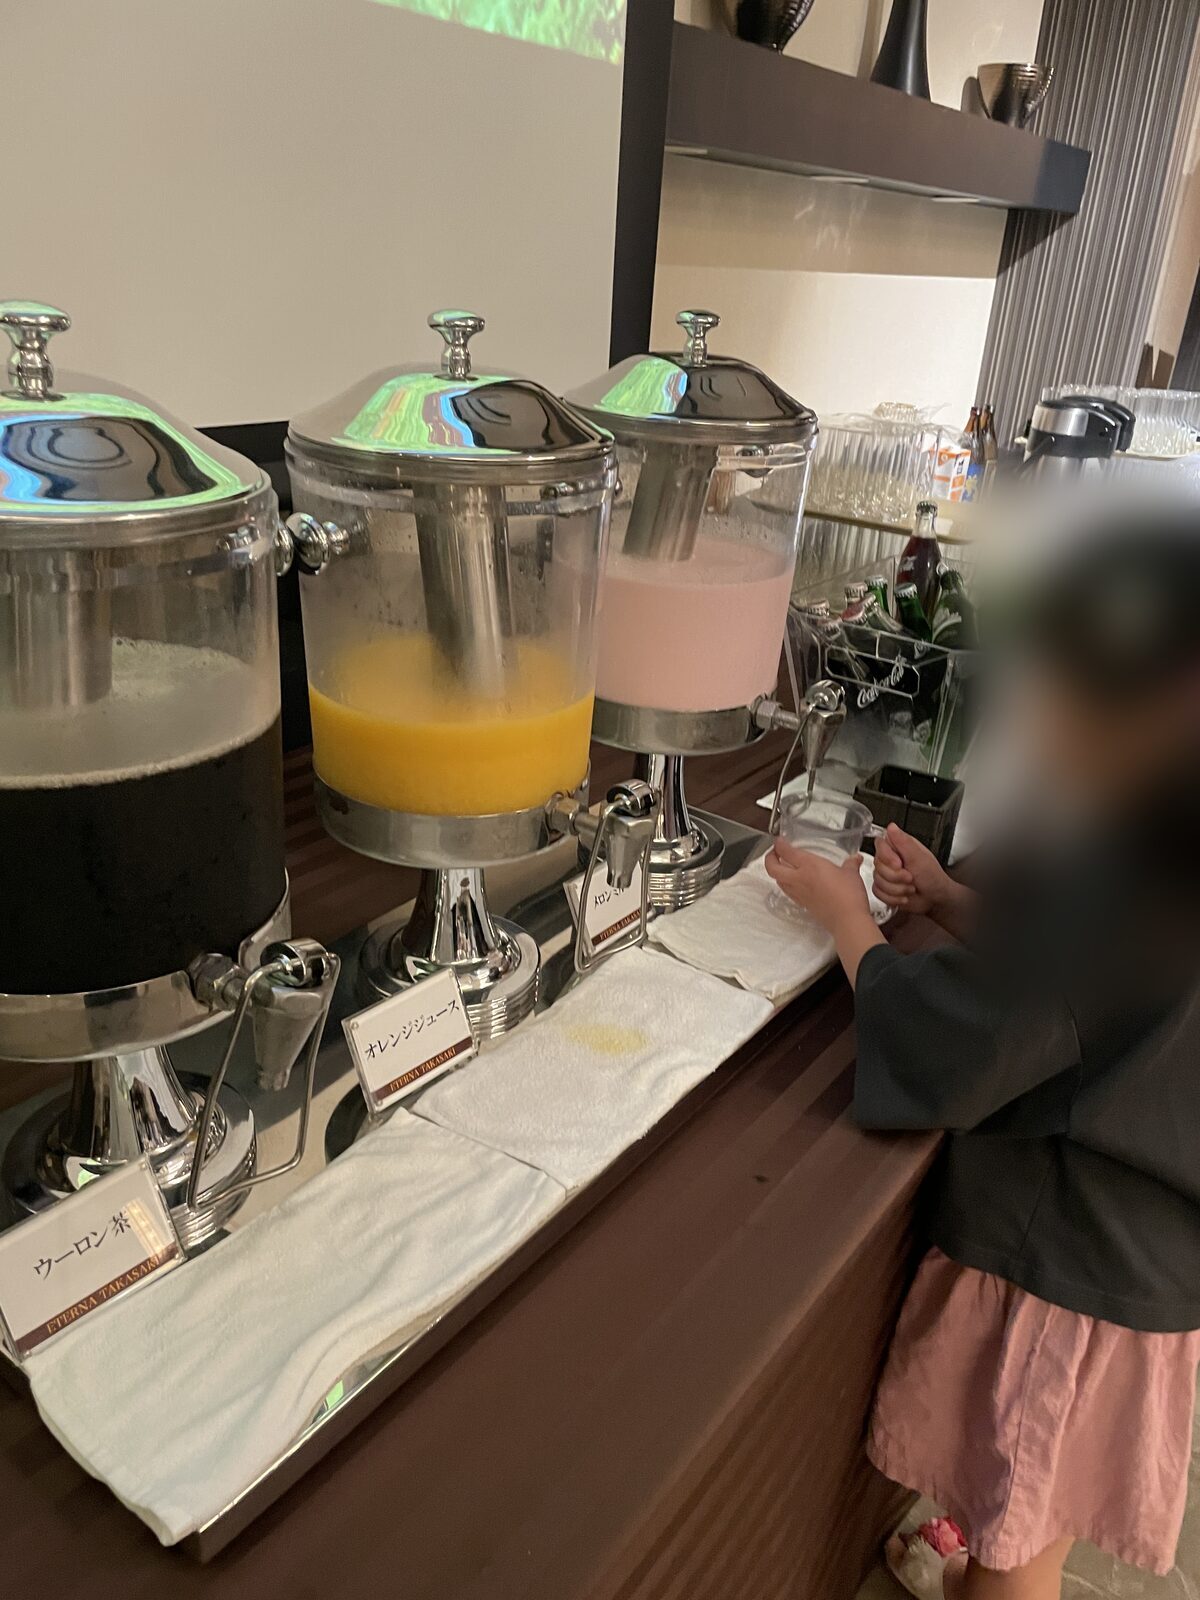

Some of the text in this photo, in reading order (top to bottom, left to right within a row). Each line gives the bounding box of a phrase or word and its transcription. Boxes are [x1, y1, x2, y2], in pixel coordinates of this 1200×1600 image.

[364, 1000, 459, 1061] オレンジジュース
[389, 1047, 456, 1092] ETERNA TAKASAKI
[33, 1210, 131, 1280] ウーロン茶
[46, 1254, 161, 1334] ETERNA TAKASAKI
